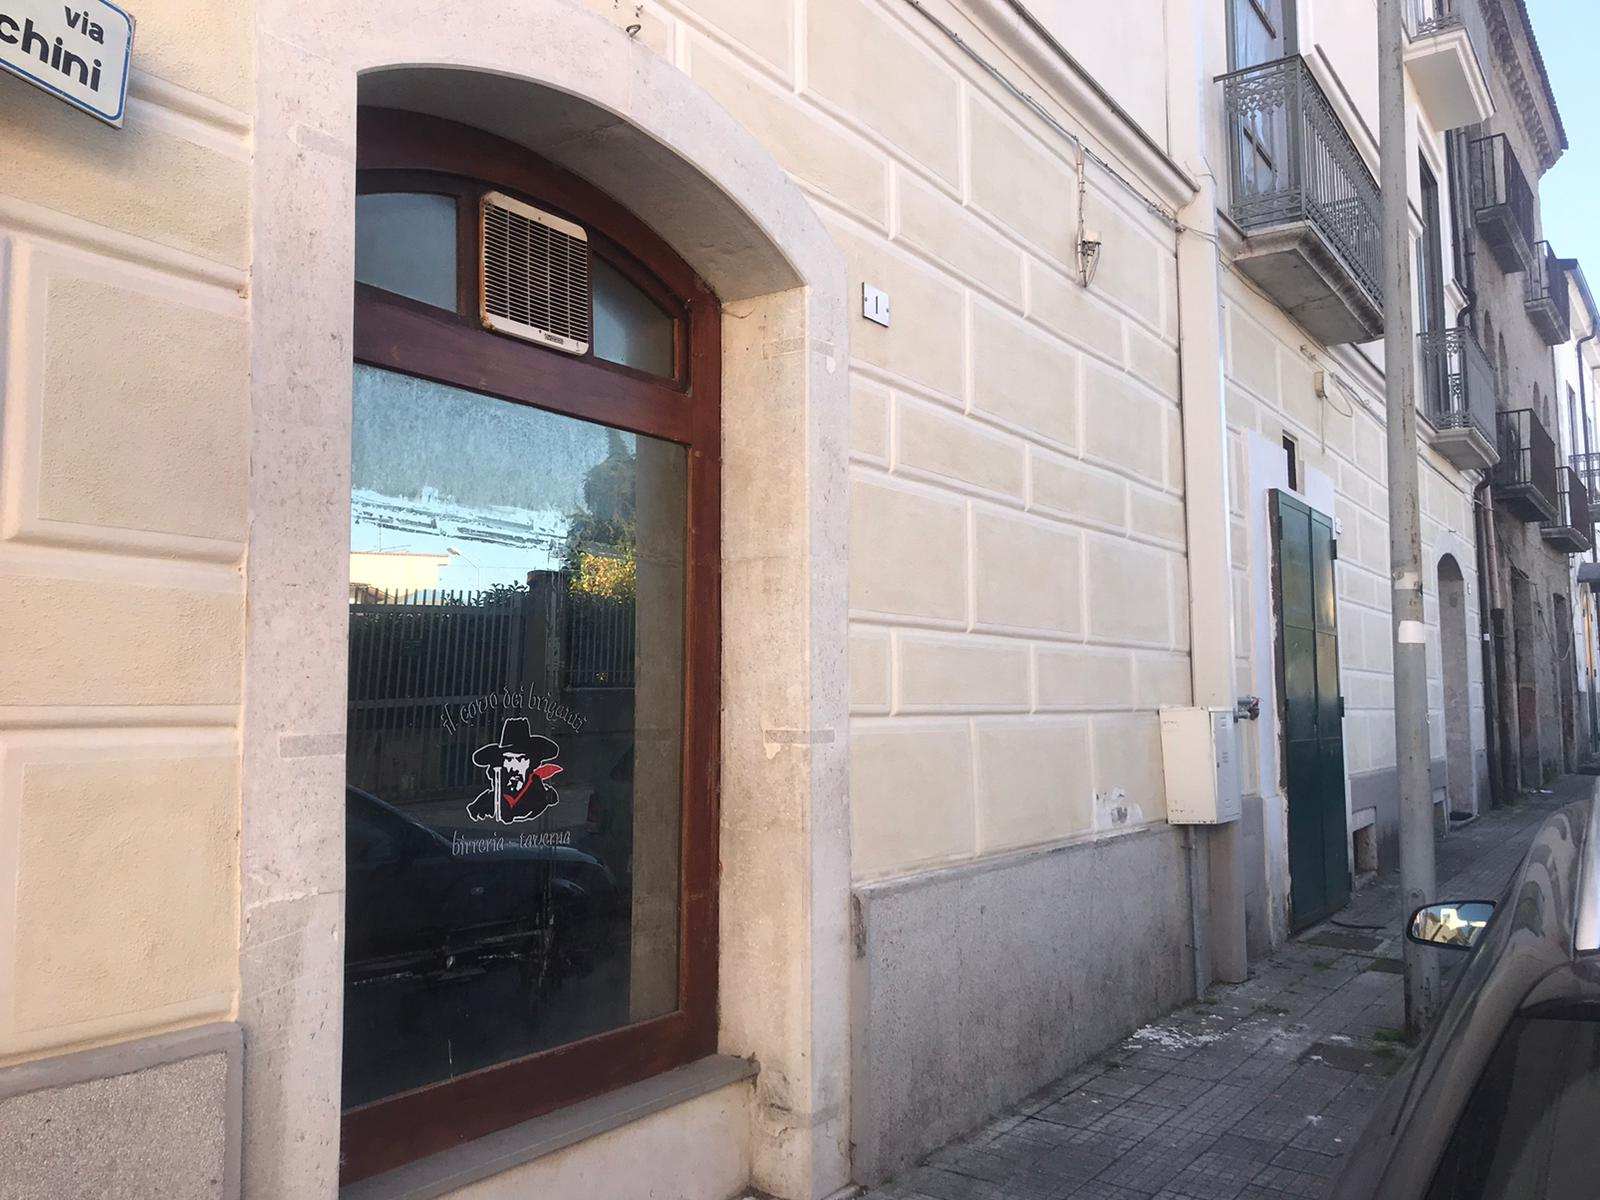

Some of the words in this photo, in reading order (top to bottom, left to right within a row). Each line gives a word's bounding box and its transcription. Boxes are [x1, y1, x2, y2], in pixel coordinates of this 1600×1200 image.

[64, 5, 105, 45] via
[0, 13, 102, 92] chini
[503, 685, 525, 709] dei
[452, 829, 505, 856] birreria
[519, 831, 571, 849] taverna
